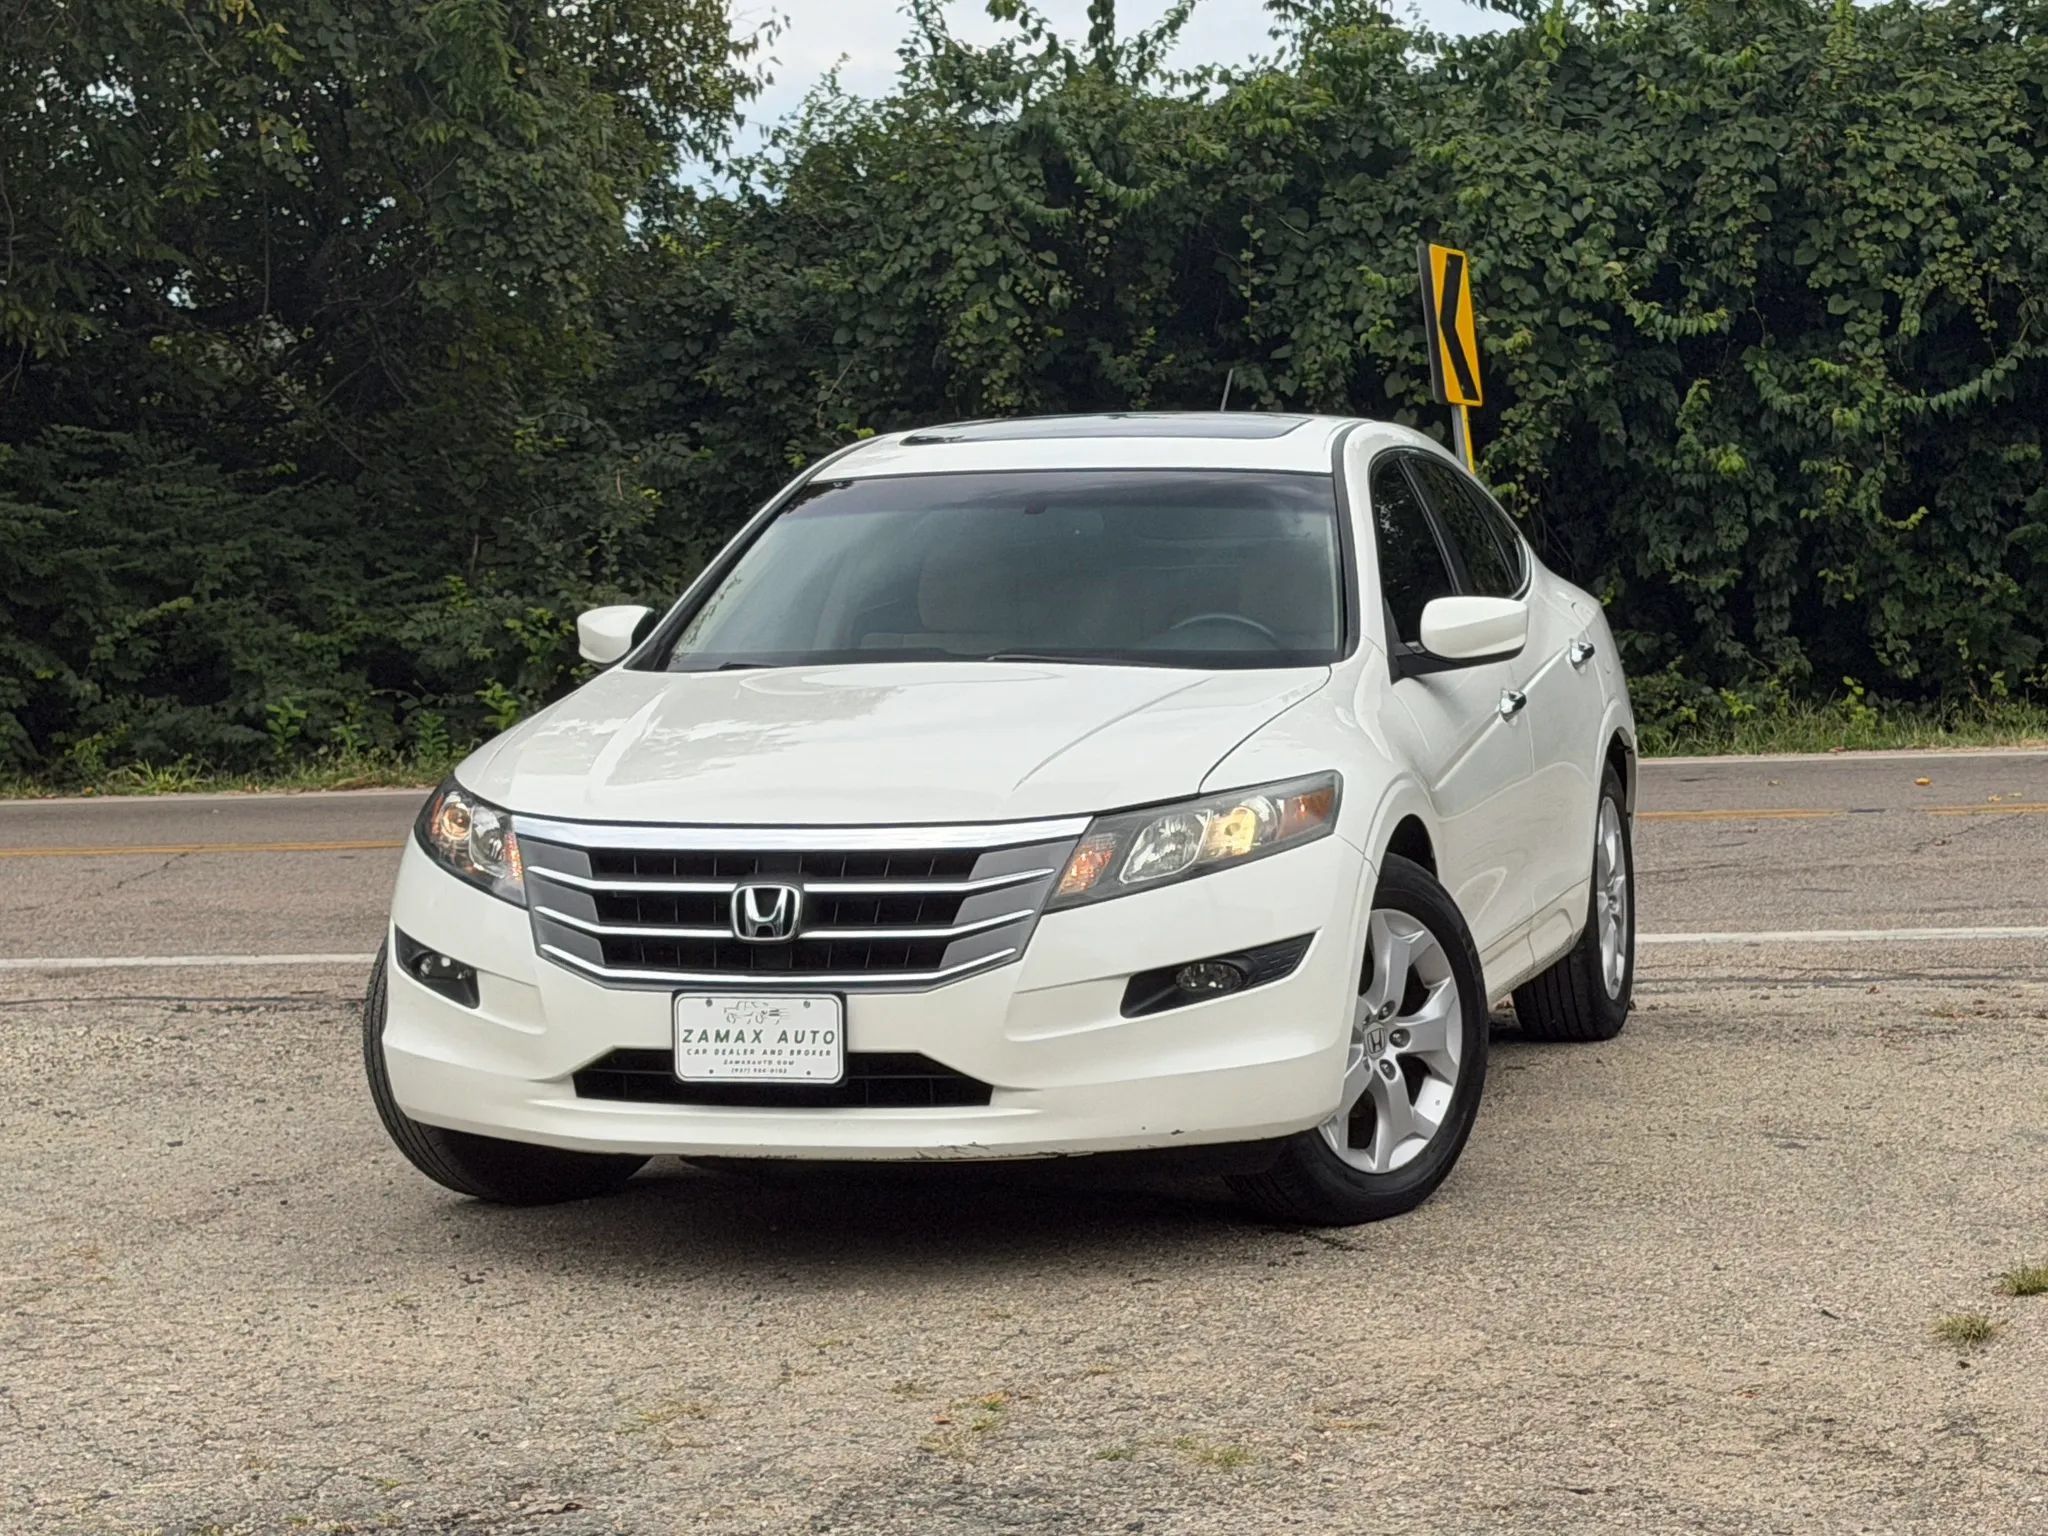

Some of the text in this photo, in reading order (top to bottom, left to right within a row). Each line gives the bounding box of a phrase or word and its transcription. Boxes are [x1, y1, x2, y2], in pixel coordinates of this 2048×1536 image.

[681, 1028, 836, 1045] ZAMAX AUTO
[686, 1048, 831, 1057] CAR DEALER AND BROKER
